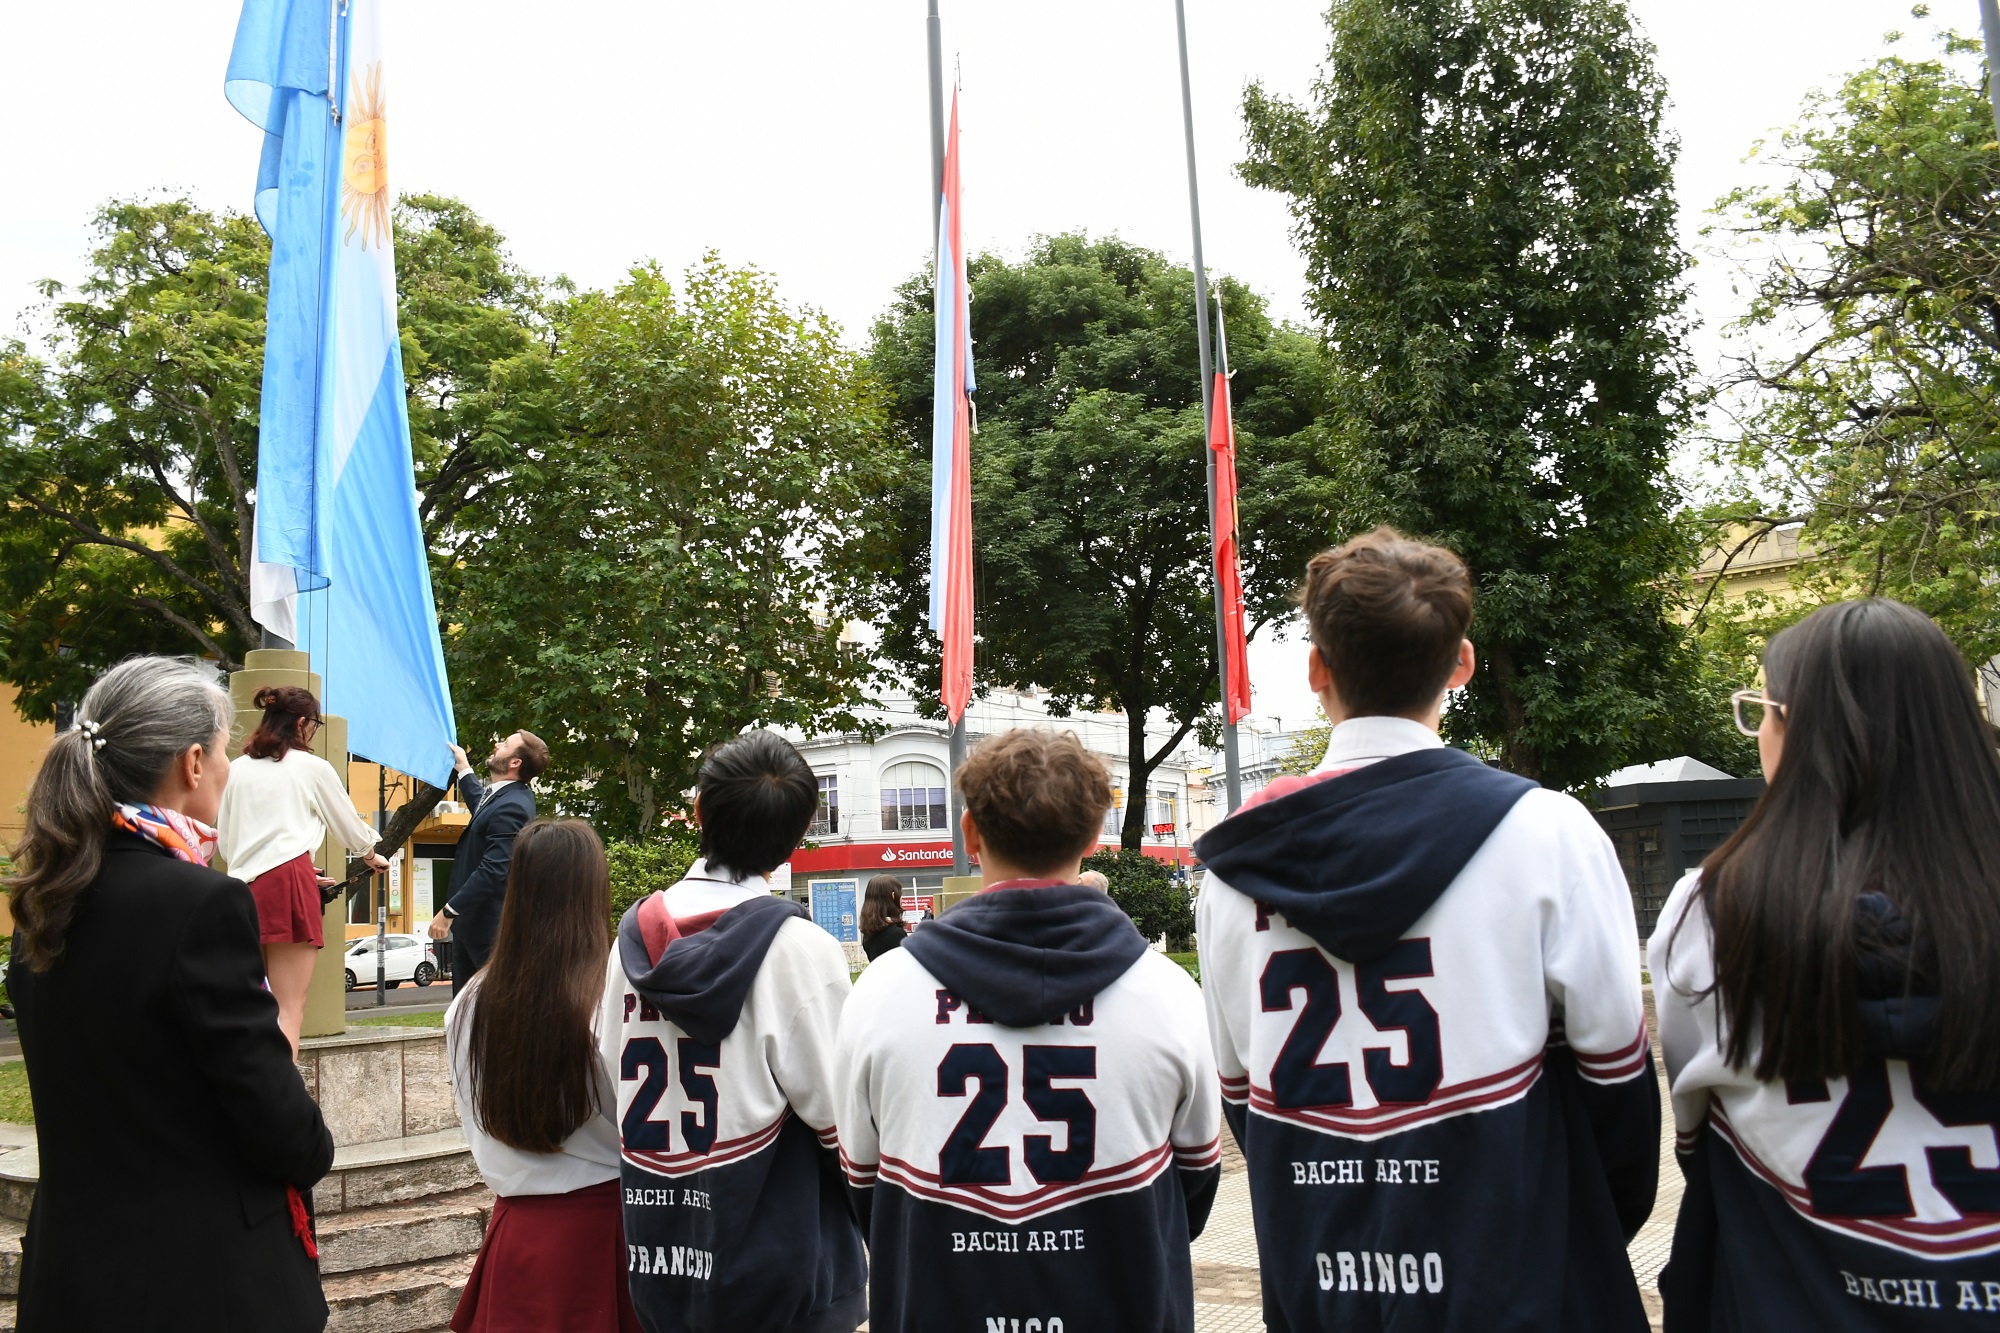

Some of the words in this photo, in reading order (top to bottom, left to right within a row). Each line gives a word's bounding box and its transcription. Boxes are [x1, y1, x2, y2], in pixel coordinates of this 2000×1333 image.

[1154, 824, 1173, 833] 08:20
[897, 847, 953, 861] Santande
[1259, 937, 1444, 1113] 25
[621, 1037, 721, 1156] 25
[937, 1043, 1097, 1188] 25
[1291, 1160, 1364, 1185] BACHI
[1375, 1159, 1440, 1184] ARTE
[625, 1188, 675, 1206] BACHI
[682, 1188, 712, 1211] ARTE
[951, 1231, 1019, 1252] BACHI
[1026, 1229, 1086, 1251] ARTE
[628, 1244, 713, 1281] FRANCHU
[1316, 1251, 1444, 1294] GRINGO
[1840, 1270, 1941, 1309] BACHI
[1956, 1281, 2000, 1312] AR
